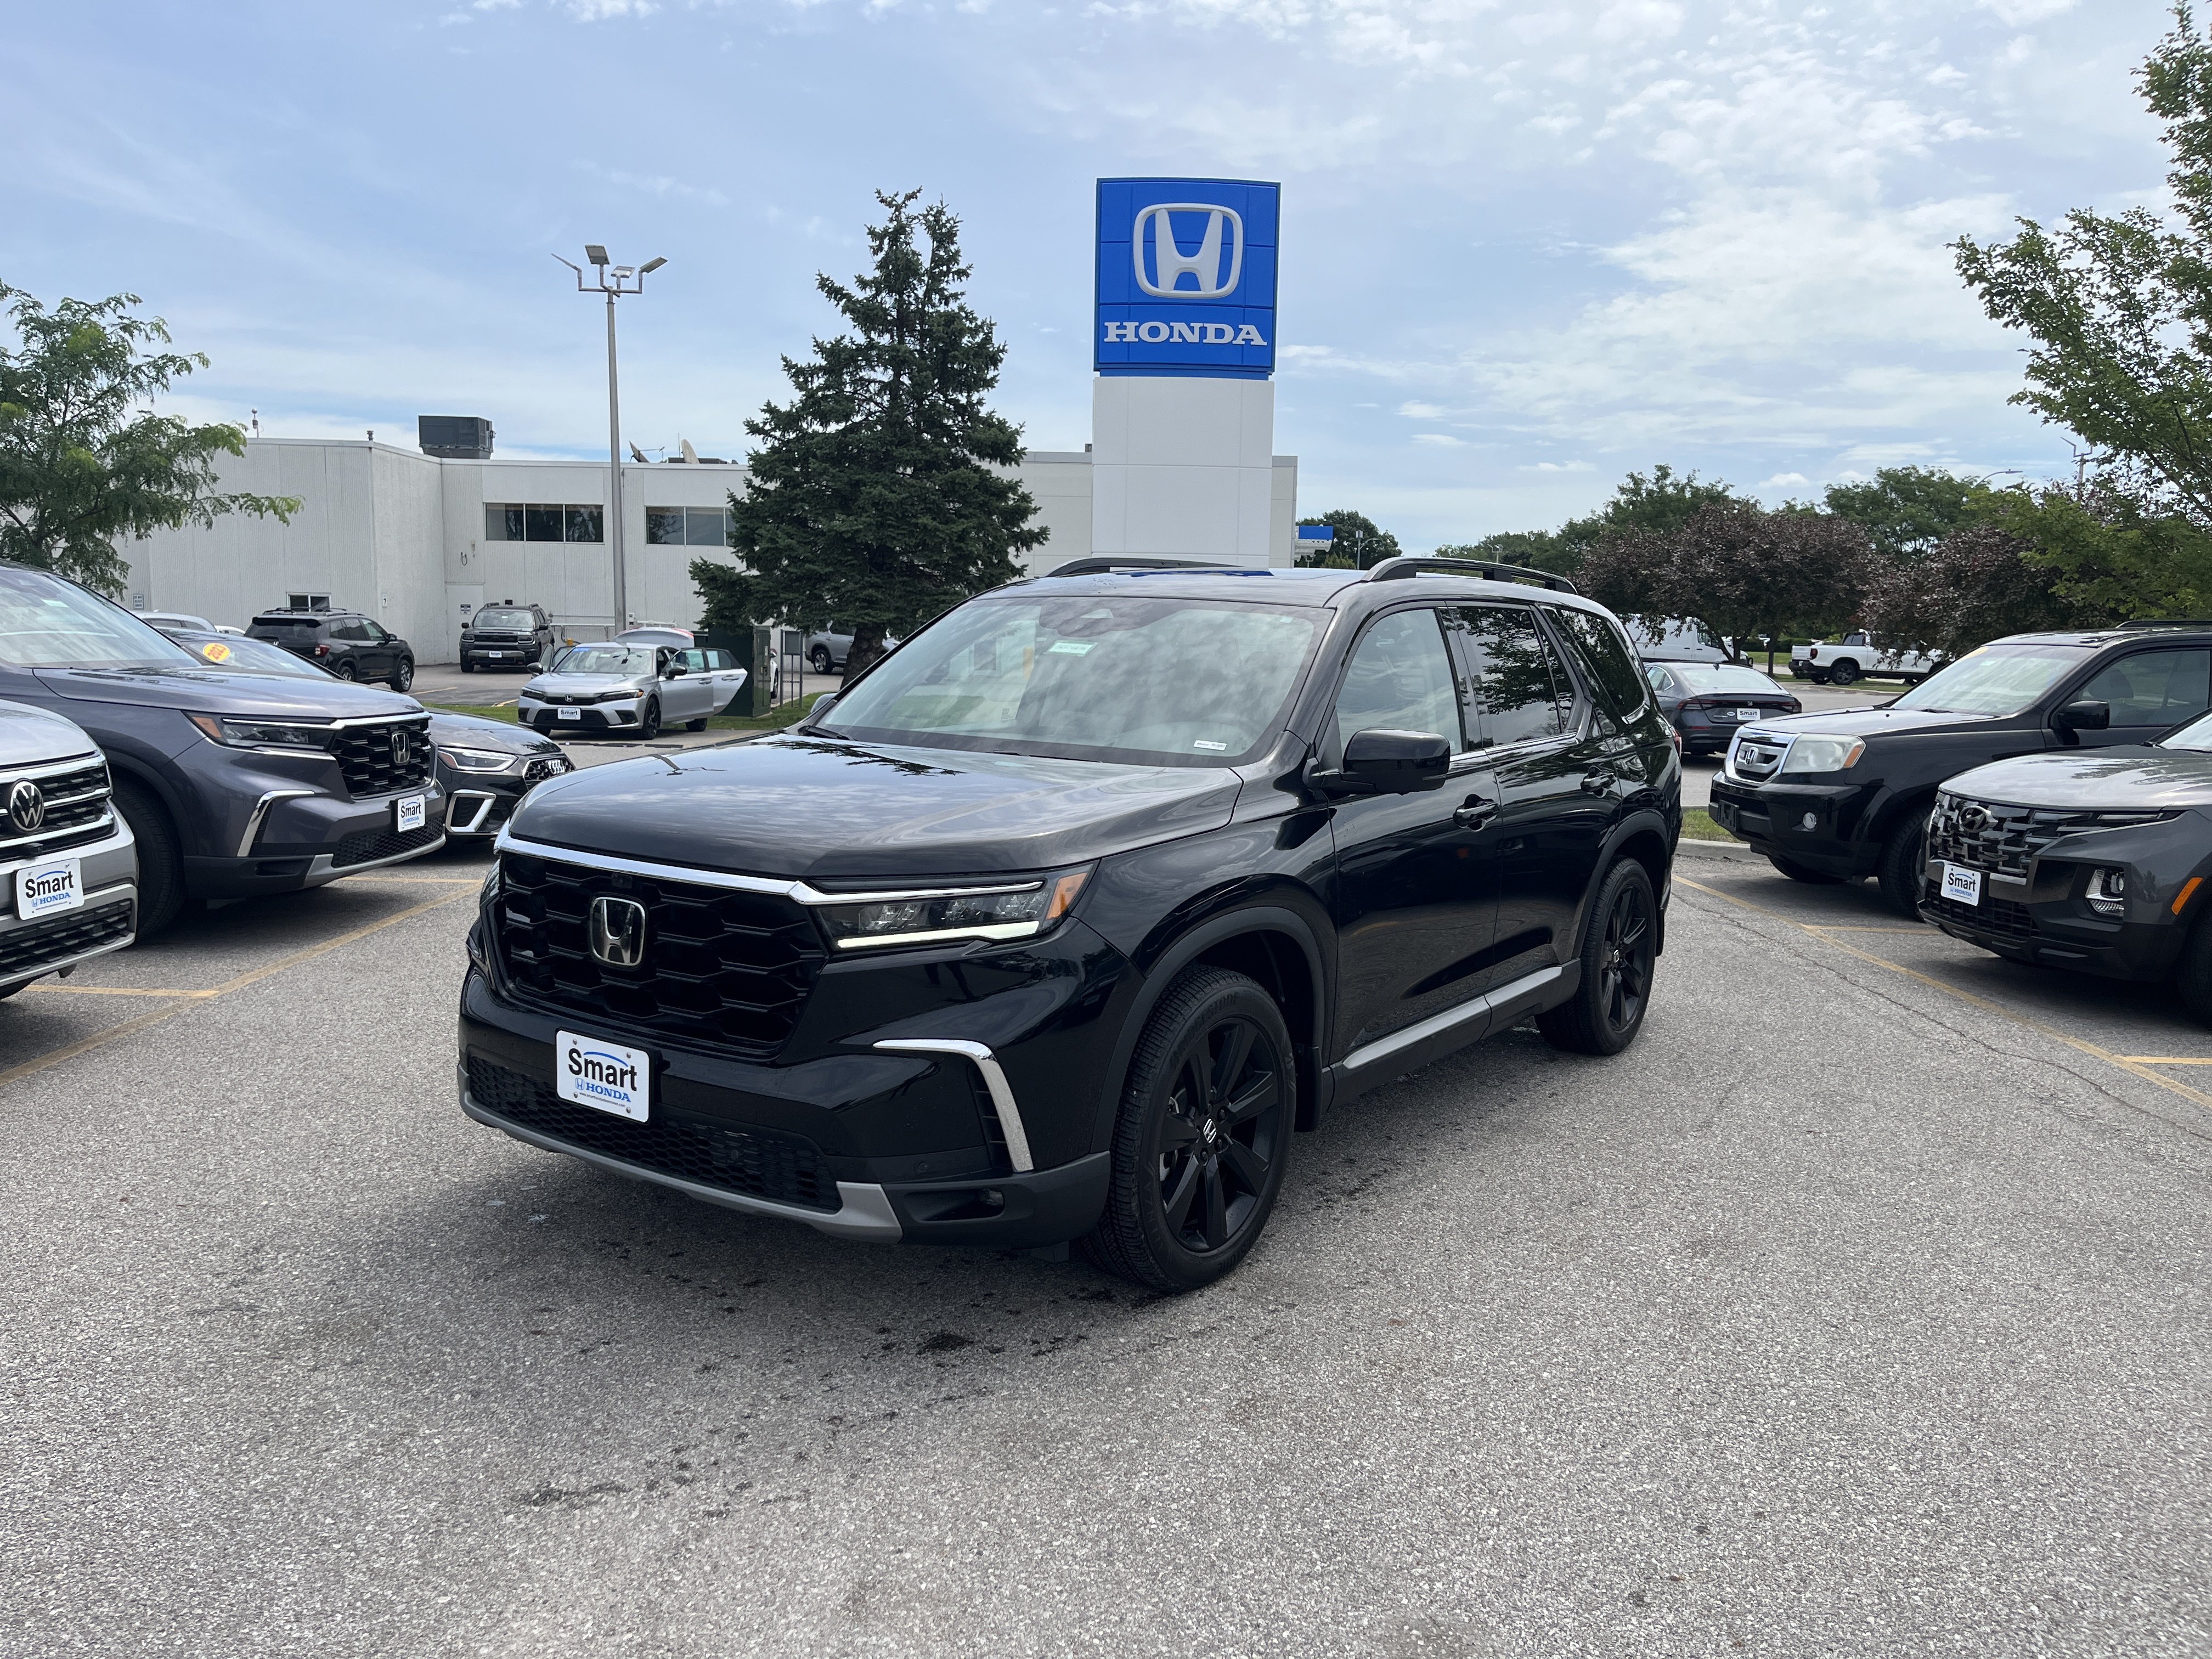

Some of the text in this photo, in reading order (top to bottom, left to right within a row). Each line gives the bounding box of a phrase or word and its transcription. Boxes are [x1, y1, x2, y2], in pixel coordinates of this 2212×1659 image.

[1103, 321, 1267, 346] HONDA
[400, 802, 421, 819] Smart
[25, 871, 74, 899] Smart
[1948, 872, 1976, 892] Smart
[39, 892, 71, 905] HONDA
[1954, 888, 1973, 897] HONDA
[568, 1048, 637, 1092] Smart
[585, 1082, 631, 1103] HONDA
